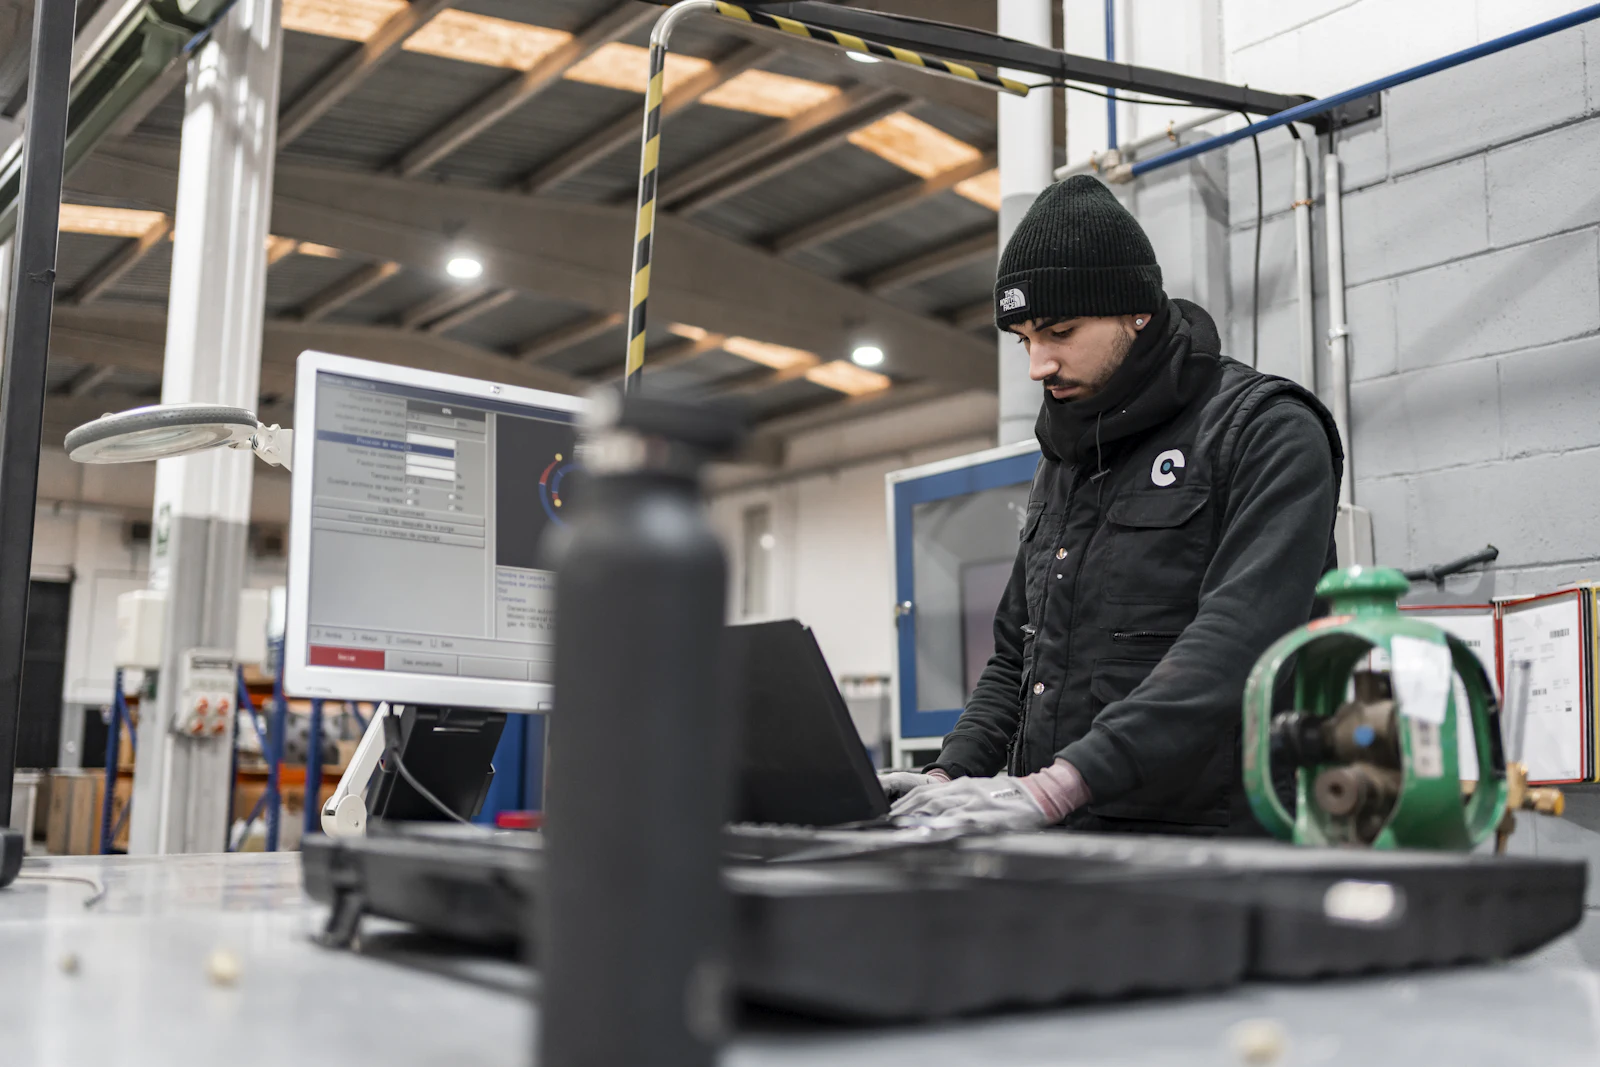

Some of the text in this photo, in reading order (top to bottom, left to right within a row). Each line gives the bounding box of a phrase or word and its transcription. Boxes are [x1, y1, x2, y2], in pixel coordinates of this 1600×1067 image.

[1004, 289, 1015, 298] THE
[1000, 296, 1015, 307] NORTH
[1003, 303, 1015, 312] FACE
